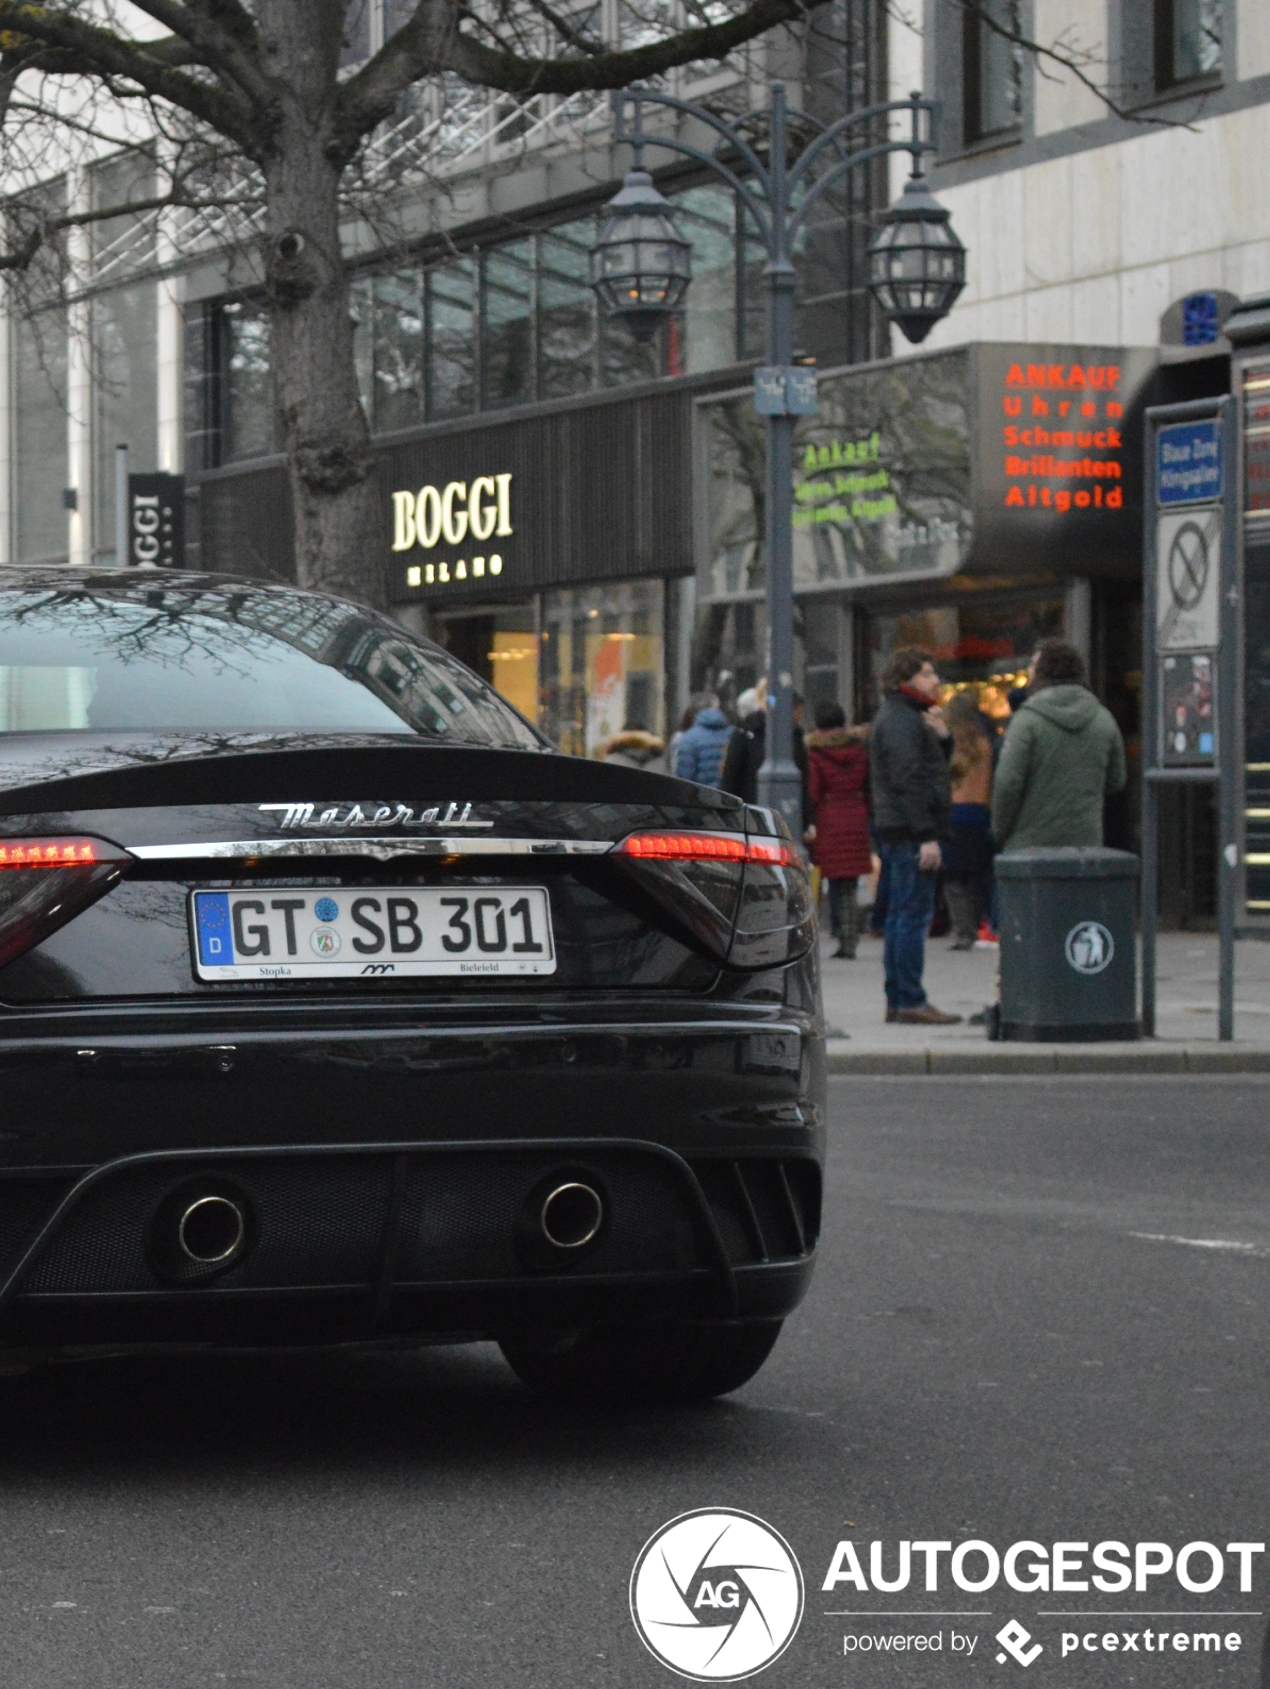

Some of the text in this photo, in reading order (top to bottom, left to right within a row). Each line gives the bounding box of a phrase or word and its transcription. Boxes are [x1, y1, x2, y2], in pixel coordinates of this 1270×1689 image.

[1005, 363, 1121, 387] ANKAUF
[1003, 425, 1122, 448] Schmuck
[1005, 454, 1121, 478] Brillanten
[391, 472, 513, 551] BOGGI
[1005, 484, 1123, 513] Altgold
[134, 495, 158, 567] GGI
[407, 554, 503, 587] MILANO
[258, 802, 494, 829] Maserati
[232, 897, 544, 956] GT SB 301
[209, 937, 221, 954] D
[259, 963, 499, 978] Stopka Bielefeld
